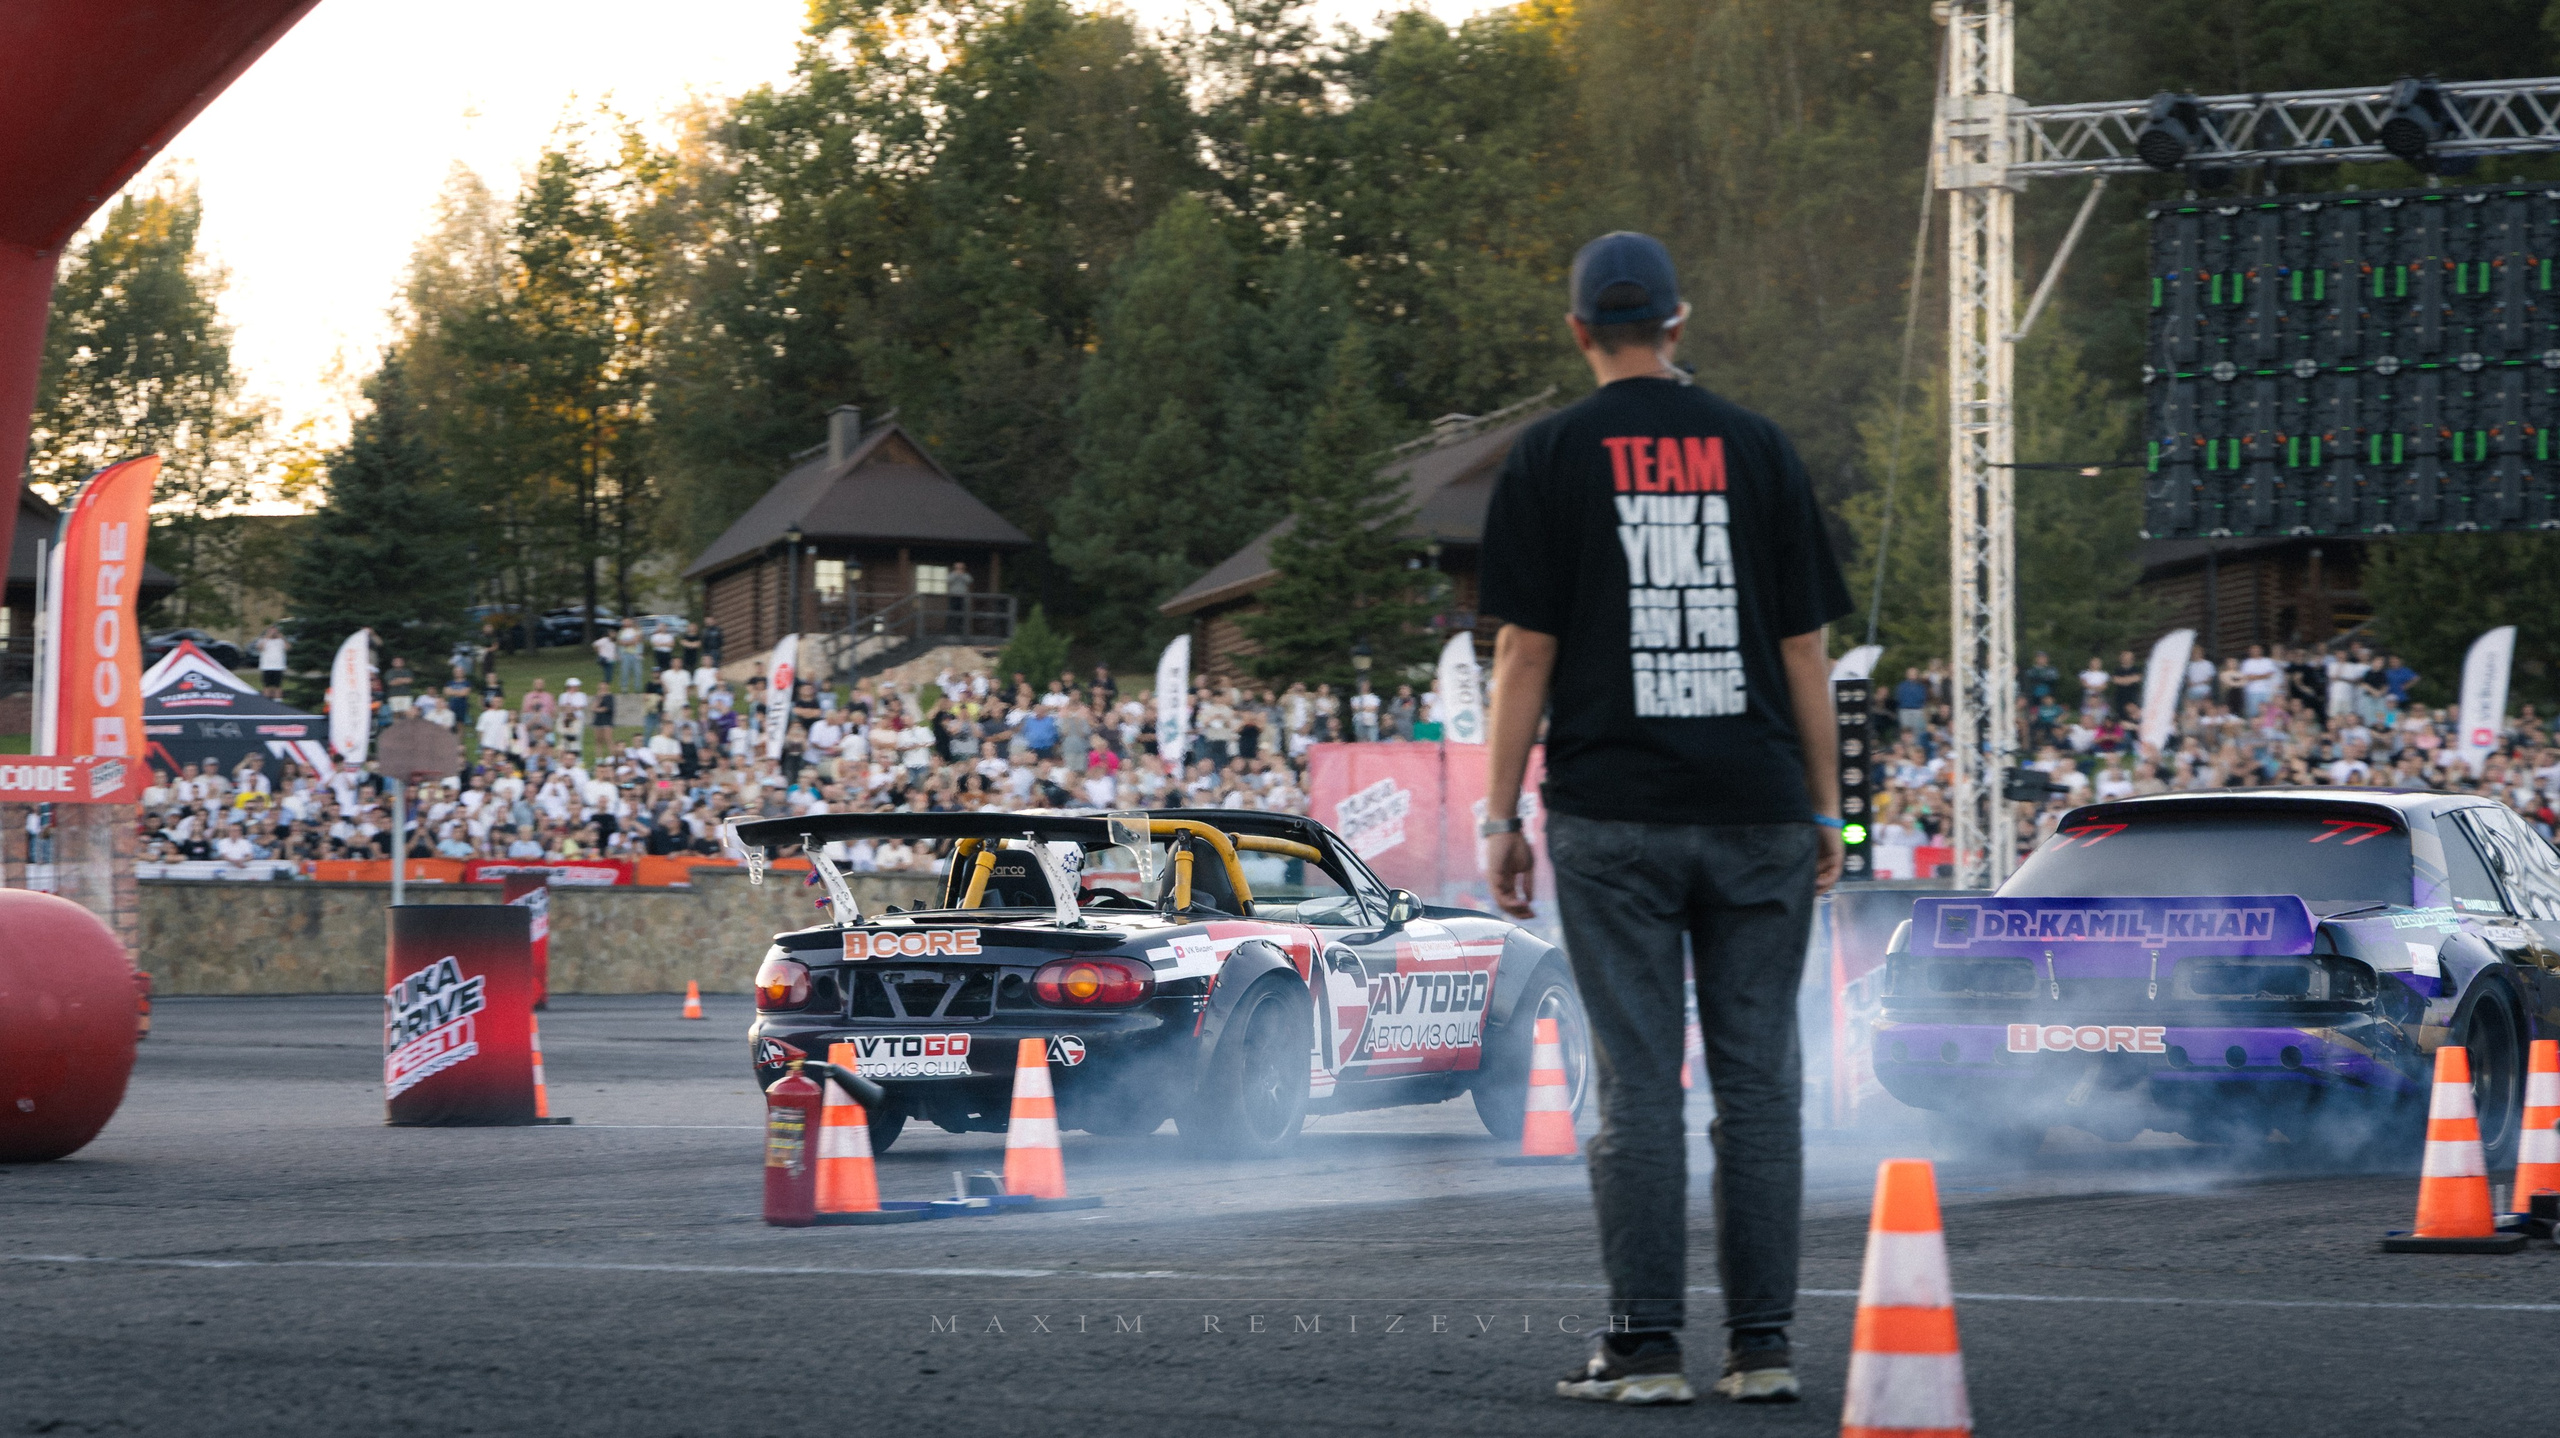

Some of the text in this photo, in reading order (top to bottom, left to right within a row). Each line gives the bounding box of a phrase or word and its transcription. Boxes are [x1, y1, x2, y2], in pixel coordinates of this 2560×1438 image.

[1602, 437, 1727, 491] TEAM
[1617, 525, 1736, 587] YUKA
[1634, 669, 1747, 717] RACING
[1371, 974, 1487, 1016] AVTOGO
[1366, 1022, 1480, 1049] АВТО ИЗ США
[893, 1062, 919, 1075] ИЗ
[924, 1061, 972, 1075] США
